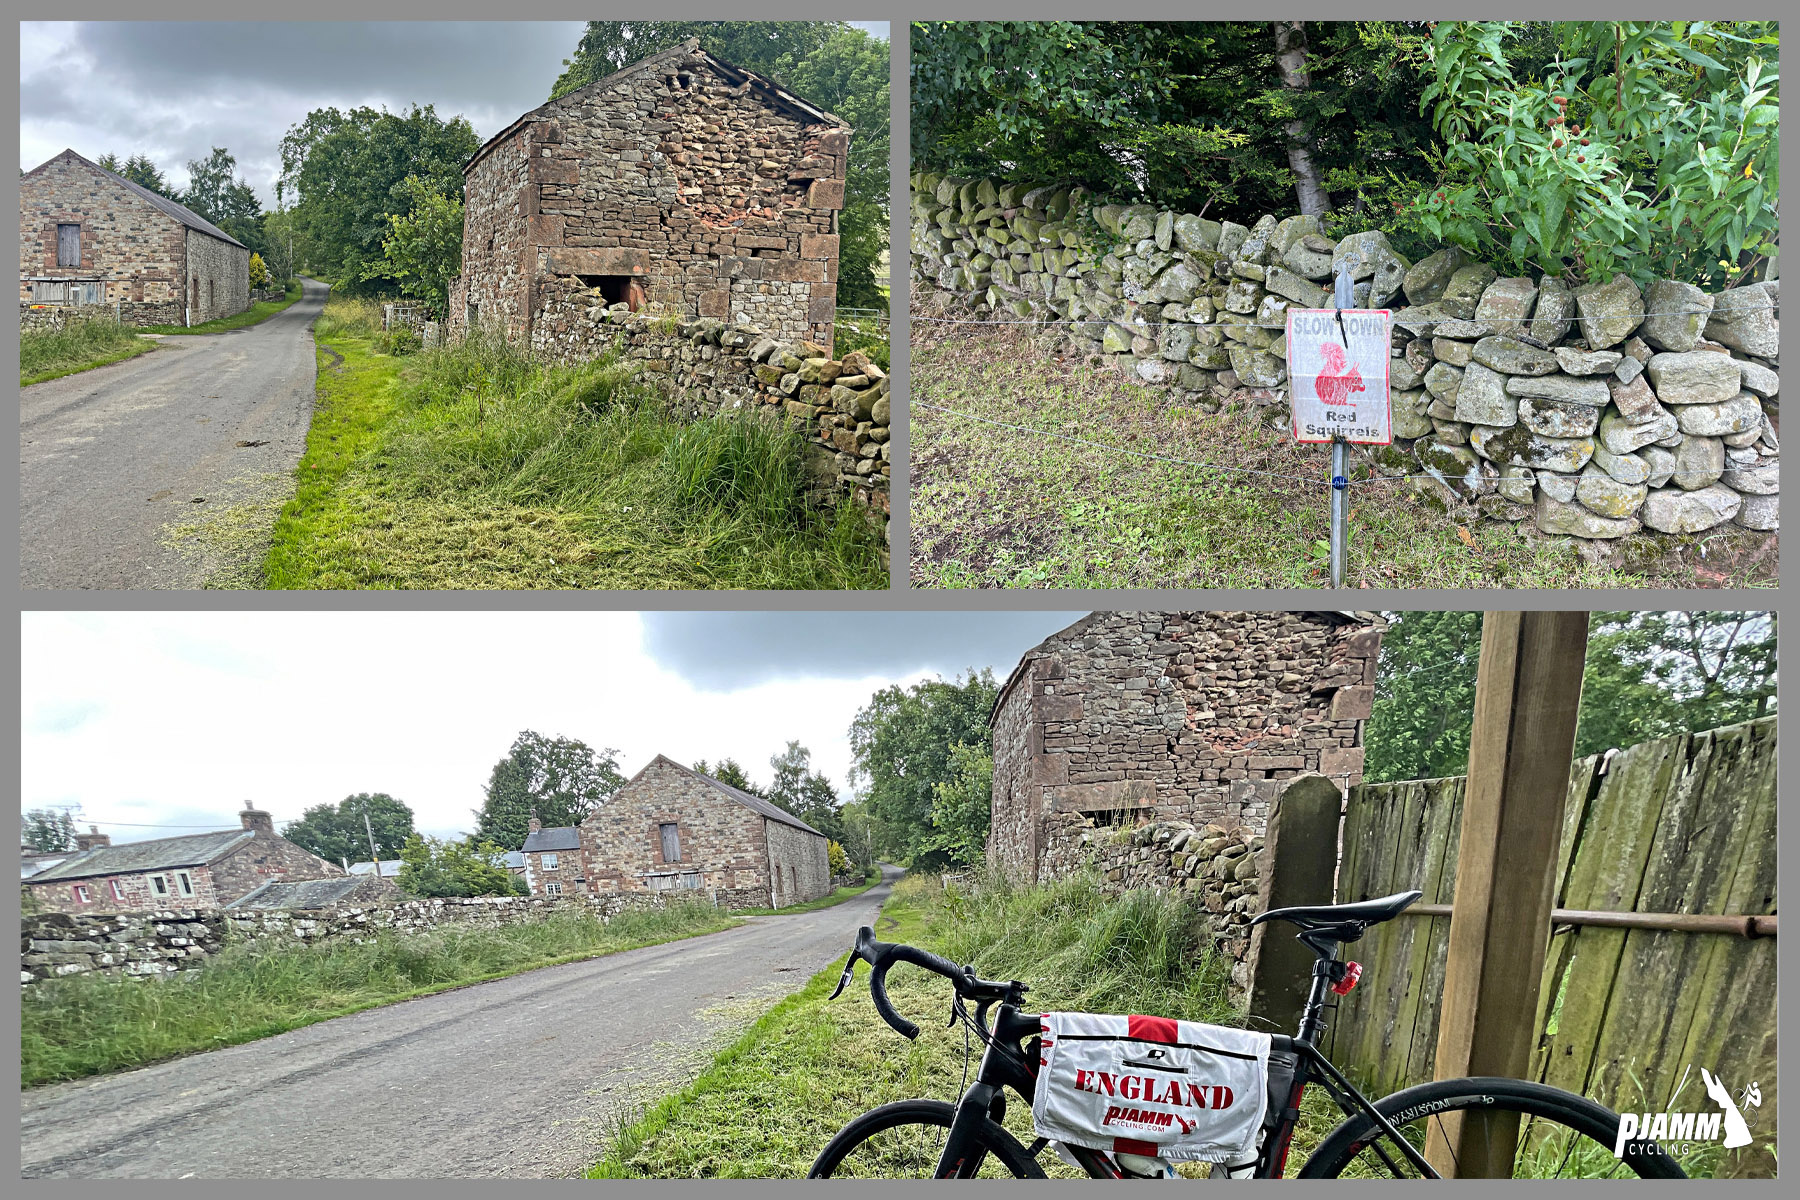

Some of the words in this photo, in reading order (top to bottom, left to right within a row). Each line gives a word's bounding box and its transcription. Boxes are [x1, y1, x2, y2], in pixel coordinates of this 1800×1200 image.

[1294, 317, 1334, 336] SLOW
[1326, 410, 1357, 423] Red
[1306, 424, 1380, 438] Squirrels
[1074, 1068, 1235, 1111] ENGLAND
[1103, 1106, 1174, 1127] PJAMM
[1110, 1119, 1165, 1133] CYCLING.COM
